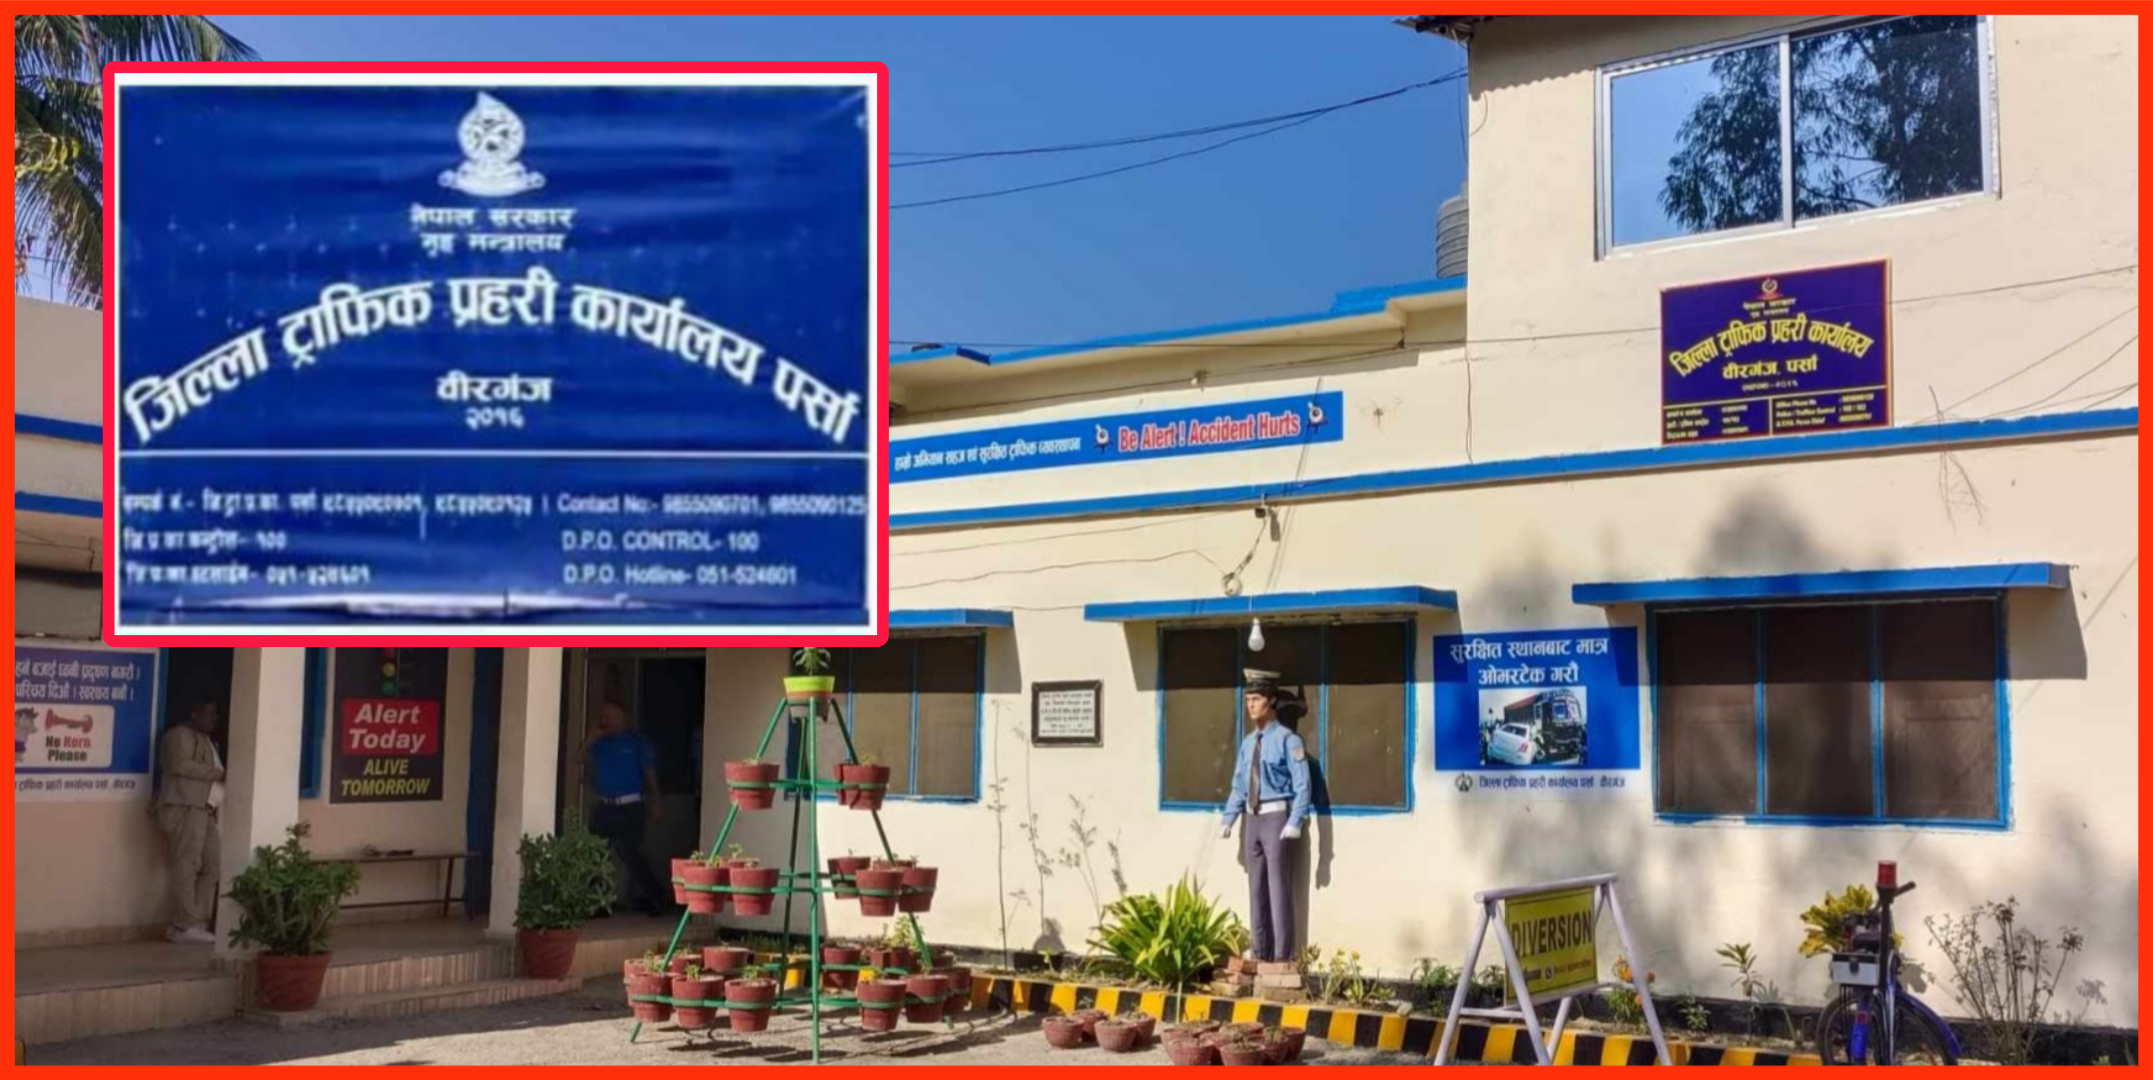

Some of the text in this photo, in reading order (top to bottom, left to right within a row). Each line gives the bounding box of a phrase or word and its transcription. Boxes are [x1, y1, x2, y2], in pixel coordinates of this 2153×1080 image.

[411, 204, 577, 229] नेपाल सरकार
[124, 266, 860, 444] जिल्ला ट्राफिक प्रहरी कार्यालय पर्सा
[1669, 313, 1875, 378] जिल्ला ट्राफिक प्रहरी कार्यालय
[1786, 354, 1819, 373] पर्सा
[437, 369, 552, 403] वीरगंज
[465, 405, 526, 428] २०१६
[1119, 426, 1139, 453] Be
[1140, 421, 1177, 450] Alert
[1188, 412, 1256, 446] Accident
[1258, 410, 1301, 440] Hurts
[557, 491, 619, 513] Contact
[561, 531, 617, 551] D.P.O.
[728, 531, 760, 552] 100
[563, 565, 619, 584] D.P.O.
[1450, 637, 1609, 664] सुरक्षित स्थानबाट मात्र
[1478, 663, 1545, 685] ओभरटेक
[353, 703, 421, 724] Alert
[46, 735, 91, 748] No Horn
[349, 728, 426, 754] Today
[47, 749, 87, 762] Please
[363, 759, 409, 776] ALIVE
[341, 778, 430, 797] TOMORROW
[1511, 910, 1592, 958] DIVERSION
